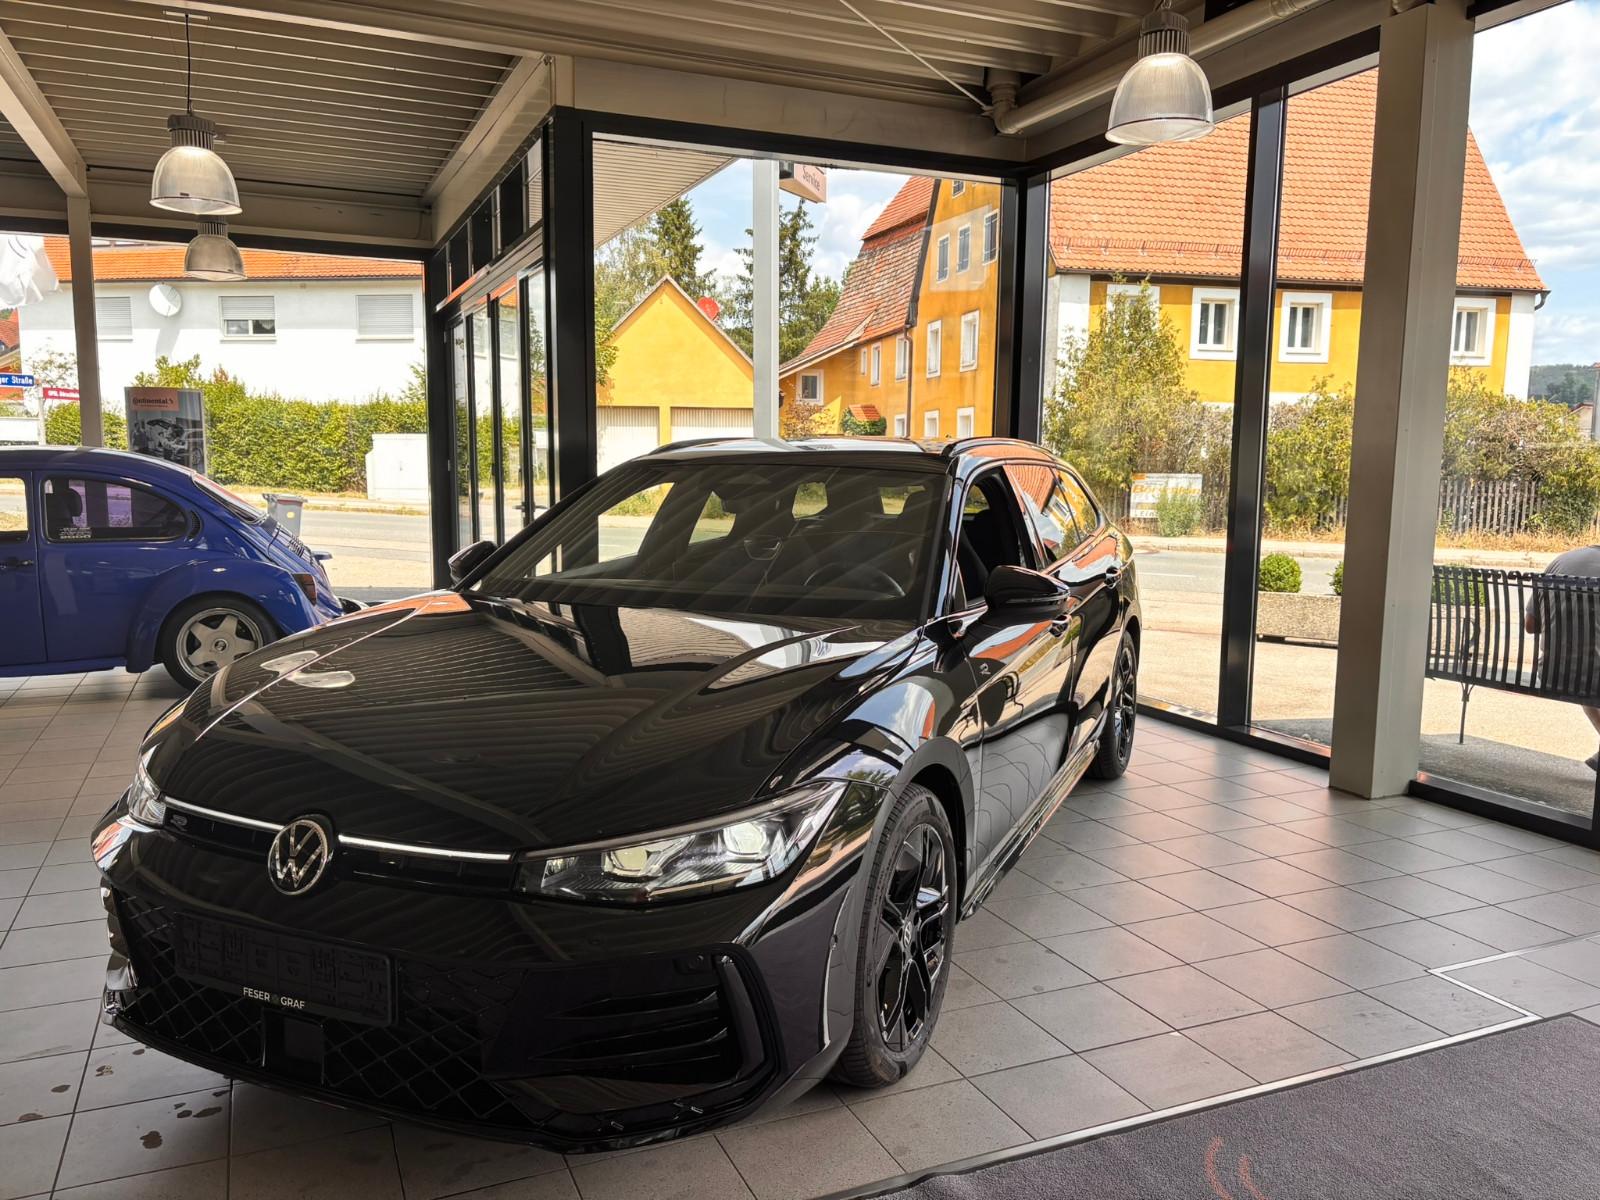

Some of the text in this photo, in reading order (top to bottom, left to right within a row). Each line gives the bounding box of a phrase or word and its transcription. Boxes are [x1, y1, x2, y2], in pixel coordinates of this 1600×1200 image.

[11, 376, 33, 385] Straße
[132, 397, 168, 405] Continental
[243, 986, 305, 1010] FESER GRAF
